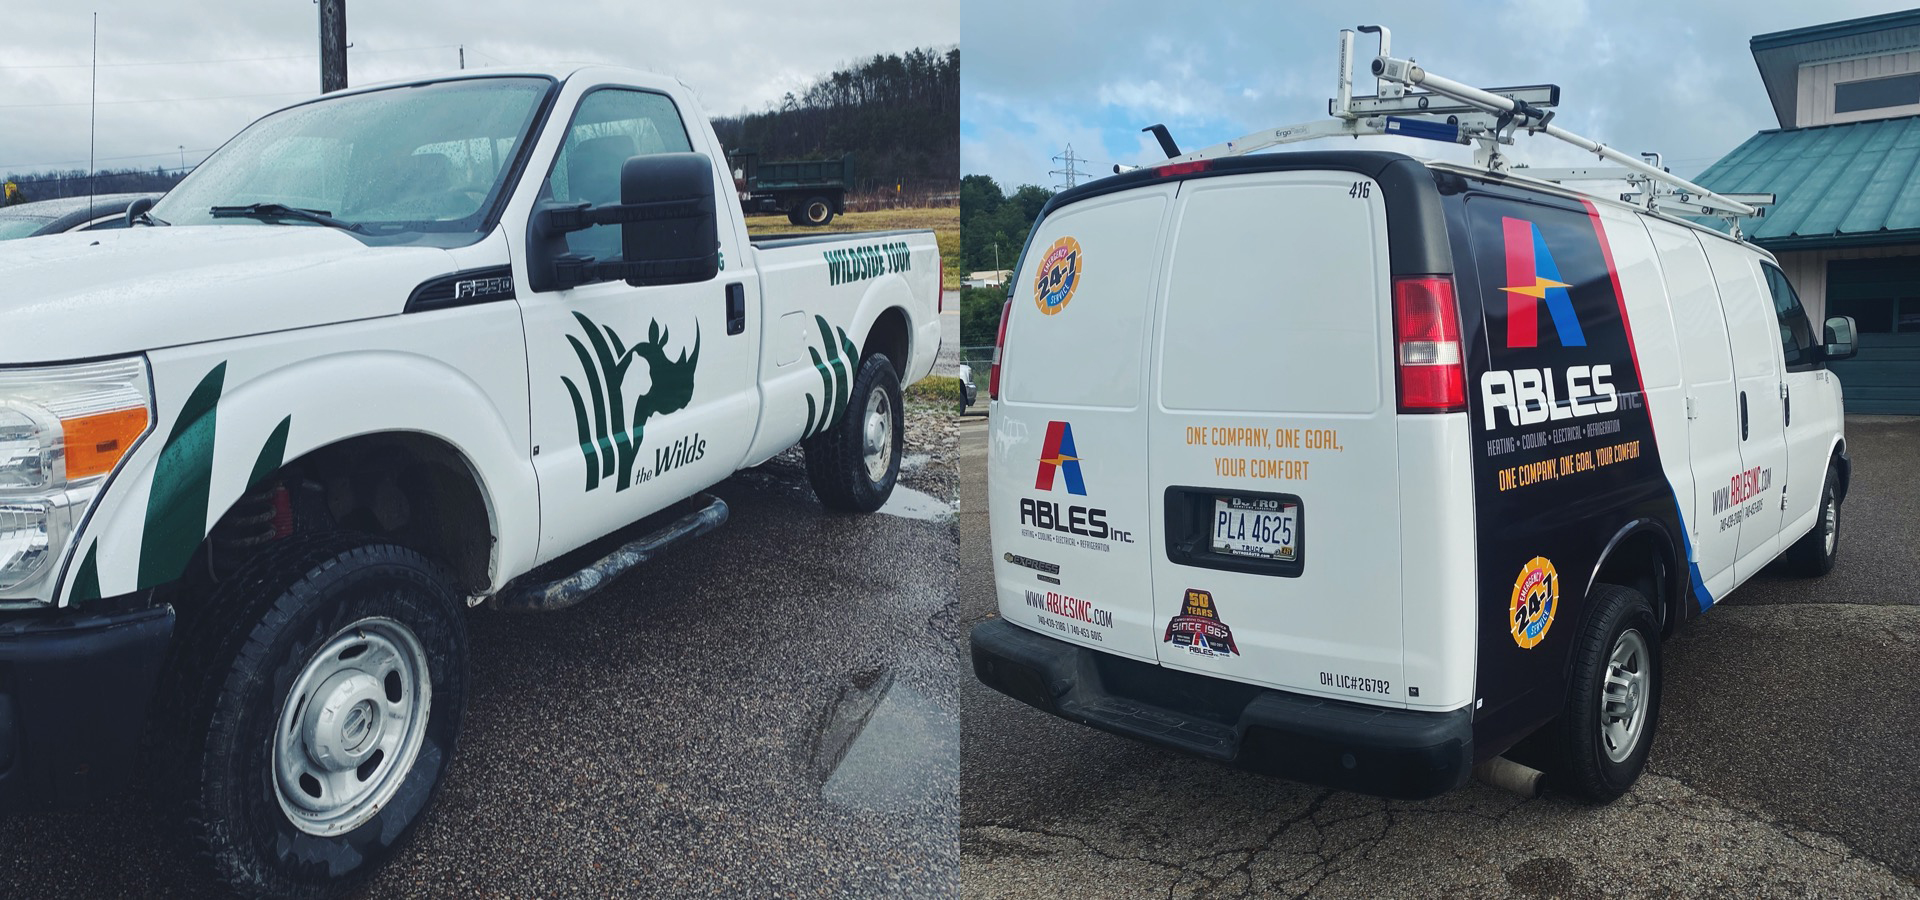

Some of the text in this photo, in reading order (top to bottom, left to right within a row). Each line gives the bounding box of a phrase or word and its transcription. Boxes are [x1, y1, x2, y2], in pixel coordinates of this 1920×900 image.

[1349, 181, 1371, 199] 416
[823, 242, 911, 286] WILDSIDE TOUR
[1038, 249, 1077, 302] 24-7
[1050, 283, 1070, 304] SERVICE
[1481, 364, 1618, 431] ABLES
[1186, 426, 1343, 453] ONE COMPANY, ONE GOAL,
[1487, 418, 1621, 457] HEATING COOLING ELECTRICAL REFRIGERATION
[635, 432, 706, 486] the Wilds
[1214, 457, 1310, 481] YOUR COMFORT
[1498, 440, 1640, 492] ONE COMPANY, ONE GOAL, YOUR COMFORT
[1712, 465, 1772, 517] WWW.ABLESINC.COM
[1020, 497, 1109, 540] ABLES
[1217, 510, 1293, 546] PLA 4625
[1241, 544, 1264, 553] TRUCK
[1014, 555, 1060, 575] EXPRESS
[1189, 592, 1209, 608] 50
[1519, 571, 1543, 602] EMERGENCY
[1025, 590, 1113, 629] WWW.ABLESINC.COM
[1187, 606, 1213, 618] YEARS
[1514, 571, 1553, 637] 24-7
[1172, 622, 1202, 632] SINCE
[1204, 624, 1228, 639] 1967
[1530, 609, 1550, 636] SERVICE
[1320, 671, 1333, 687] OH
[1336, 674, 1390, 695] LIC#26792
